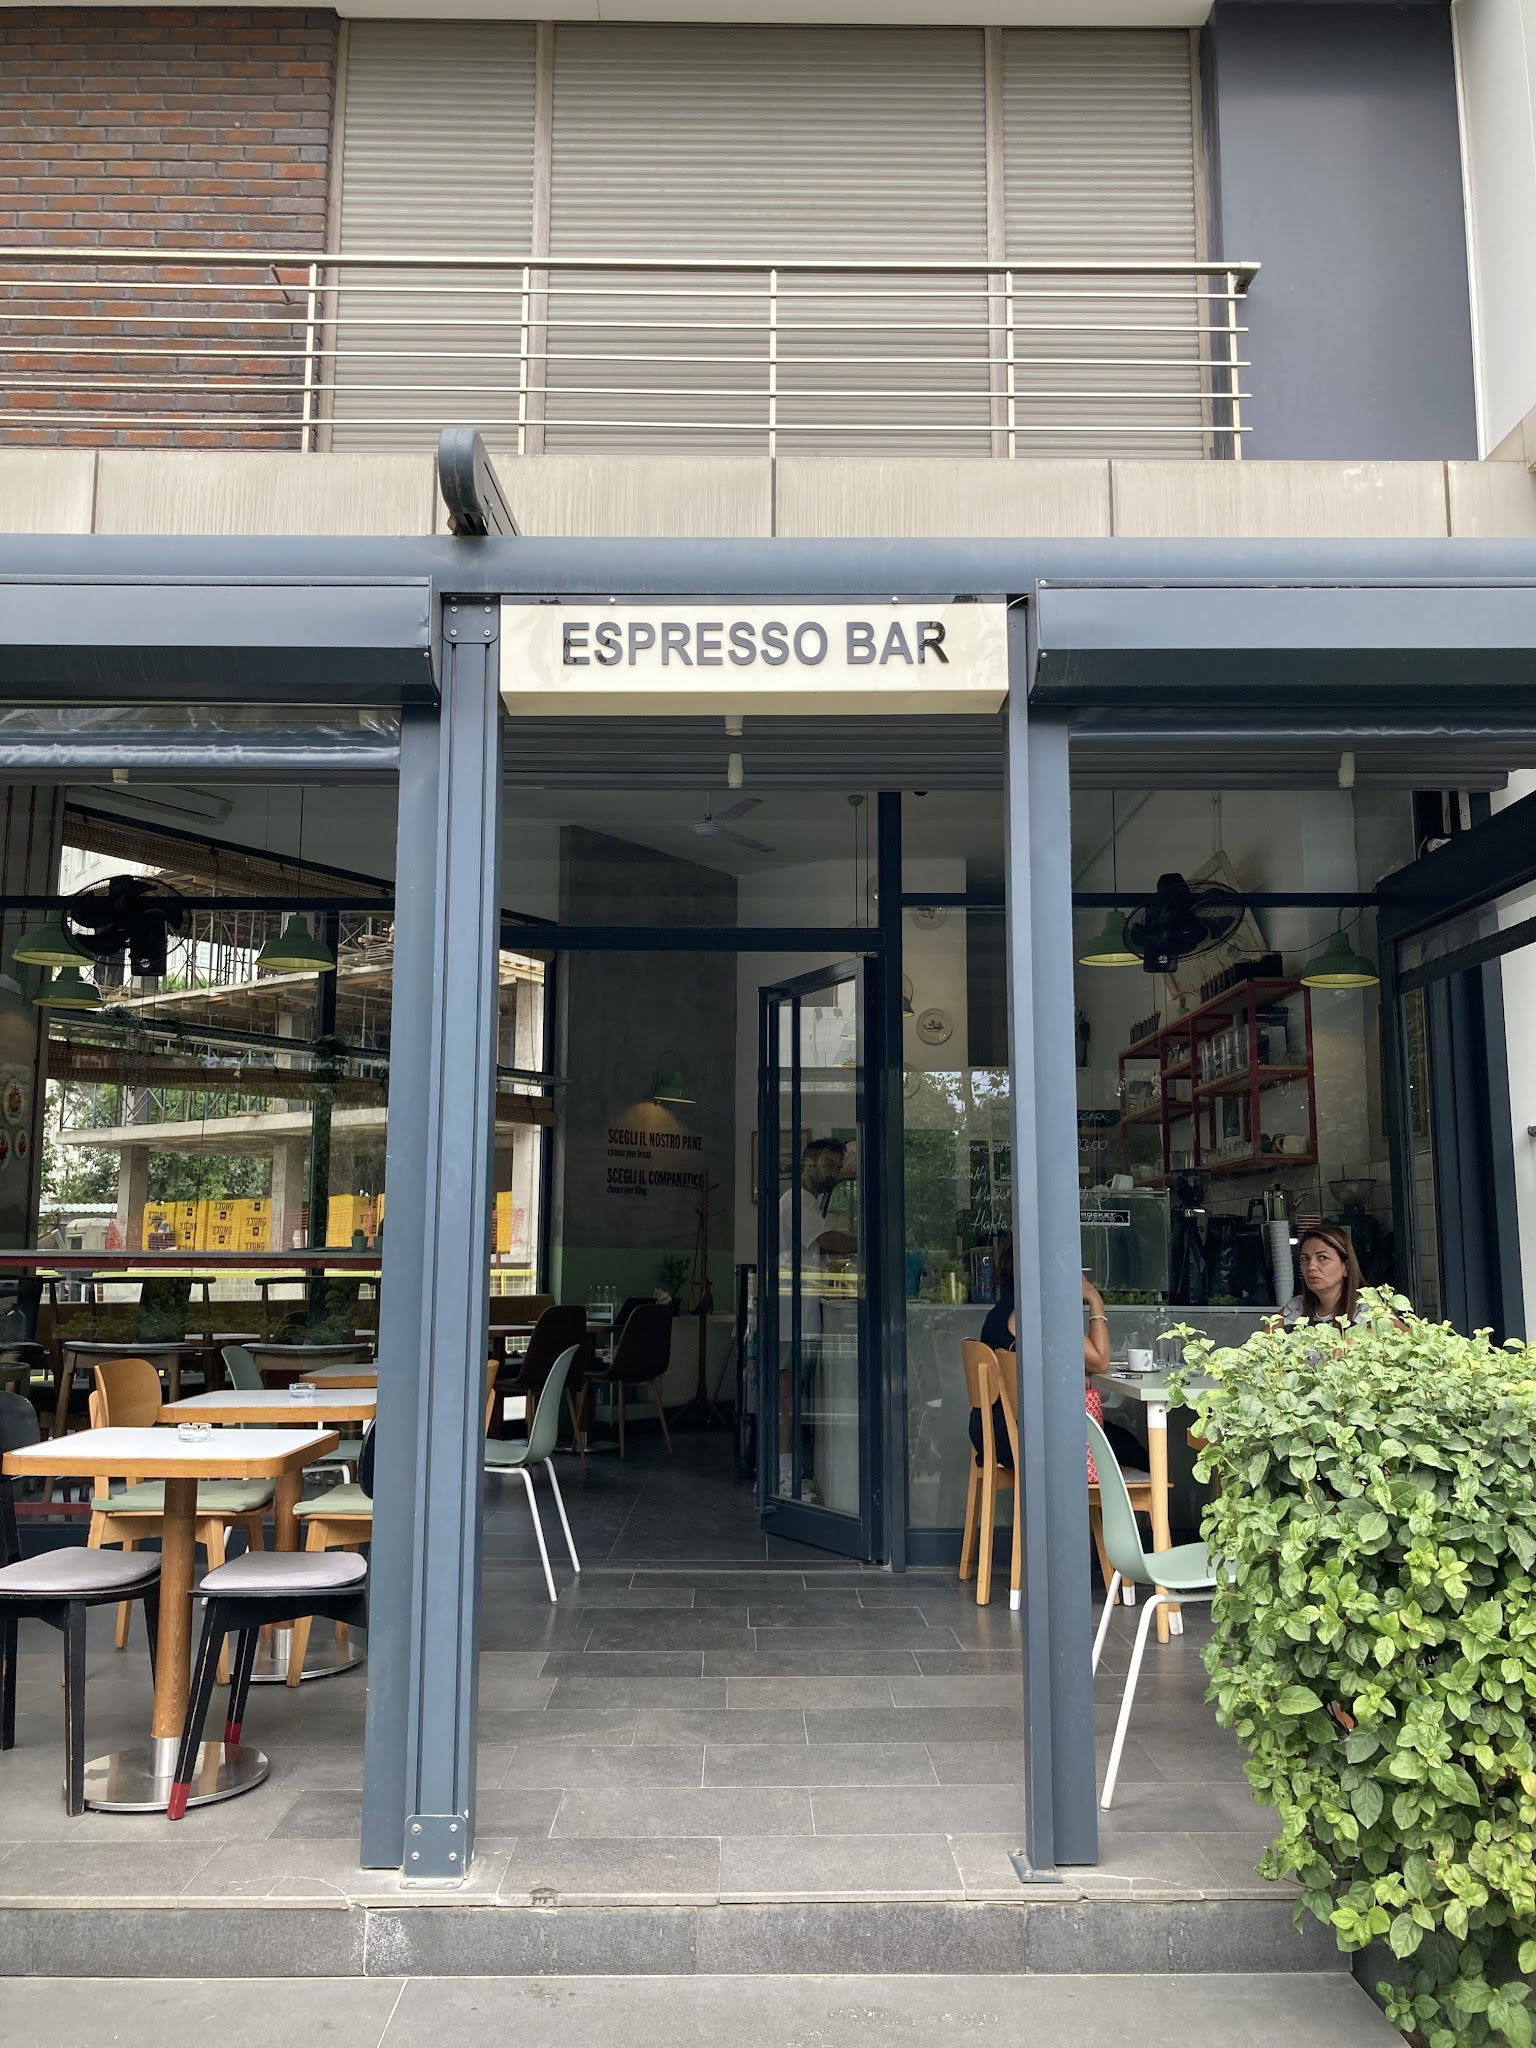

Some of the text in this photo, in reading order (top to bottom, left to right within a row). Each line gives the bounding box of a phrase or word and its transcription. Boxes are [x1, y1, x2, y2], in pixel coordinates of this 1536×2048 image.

[562, 620, 950, 666] ESPRESSO BAR
[608, 1129, 703, 1152] SCEGLI IL NOSTRO PANE
[607, 1168, 637, 1184] SCEGLI
[639, 1170, 647, 1185] IL
